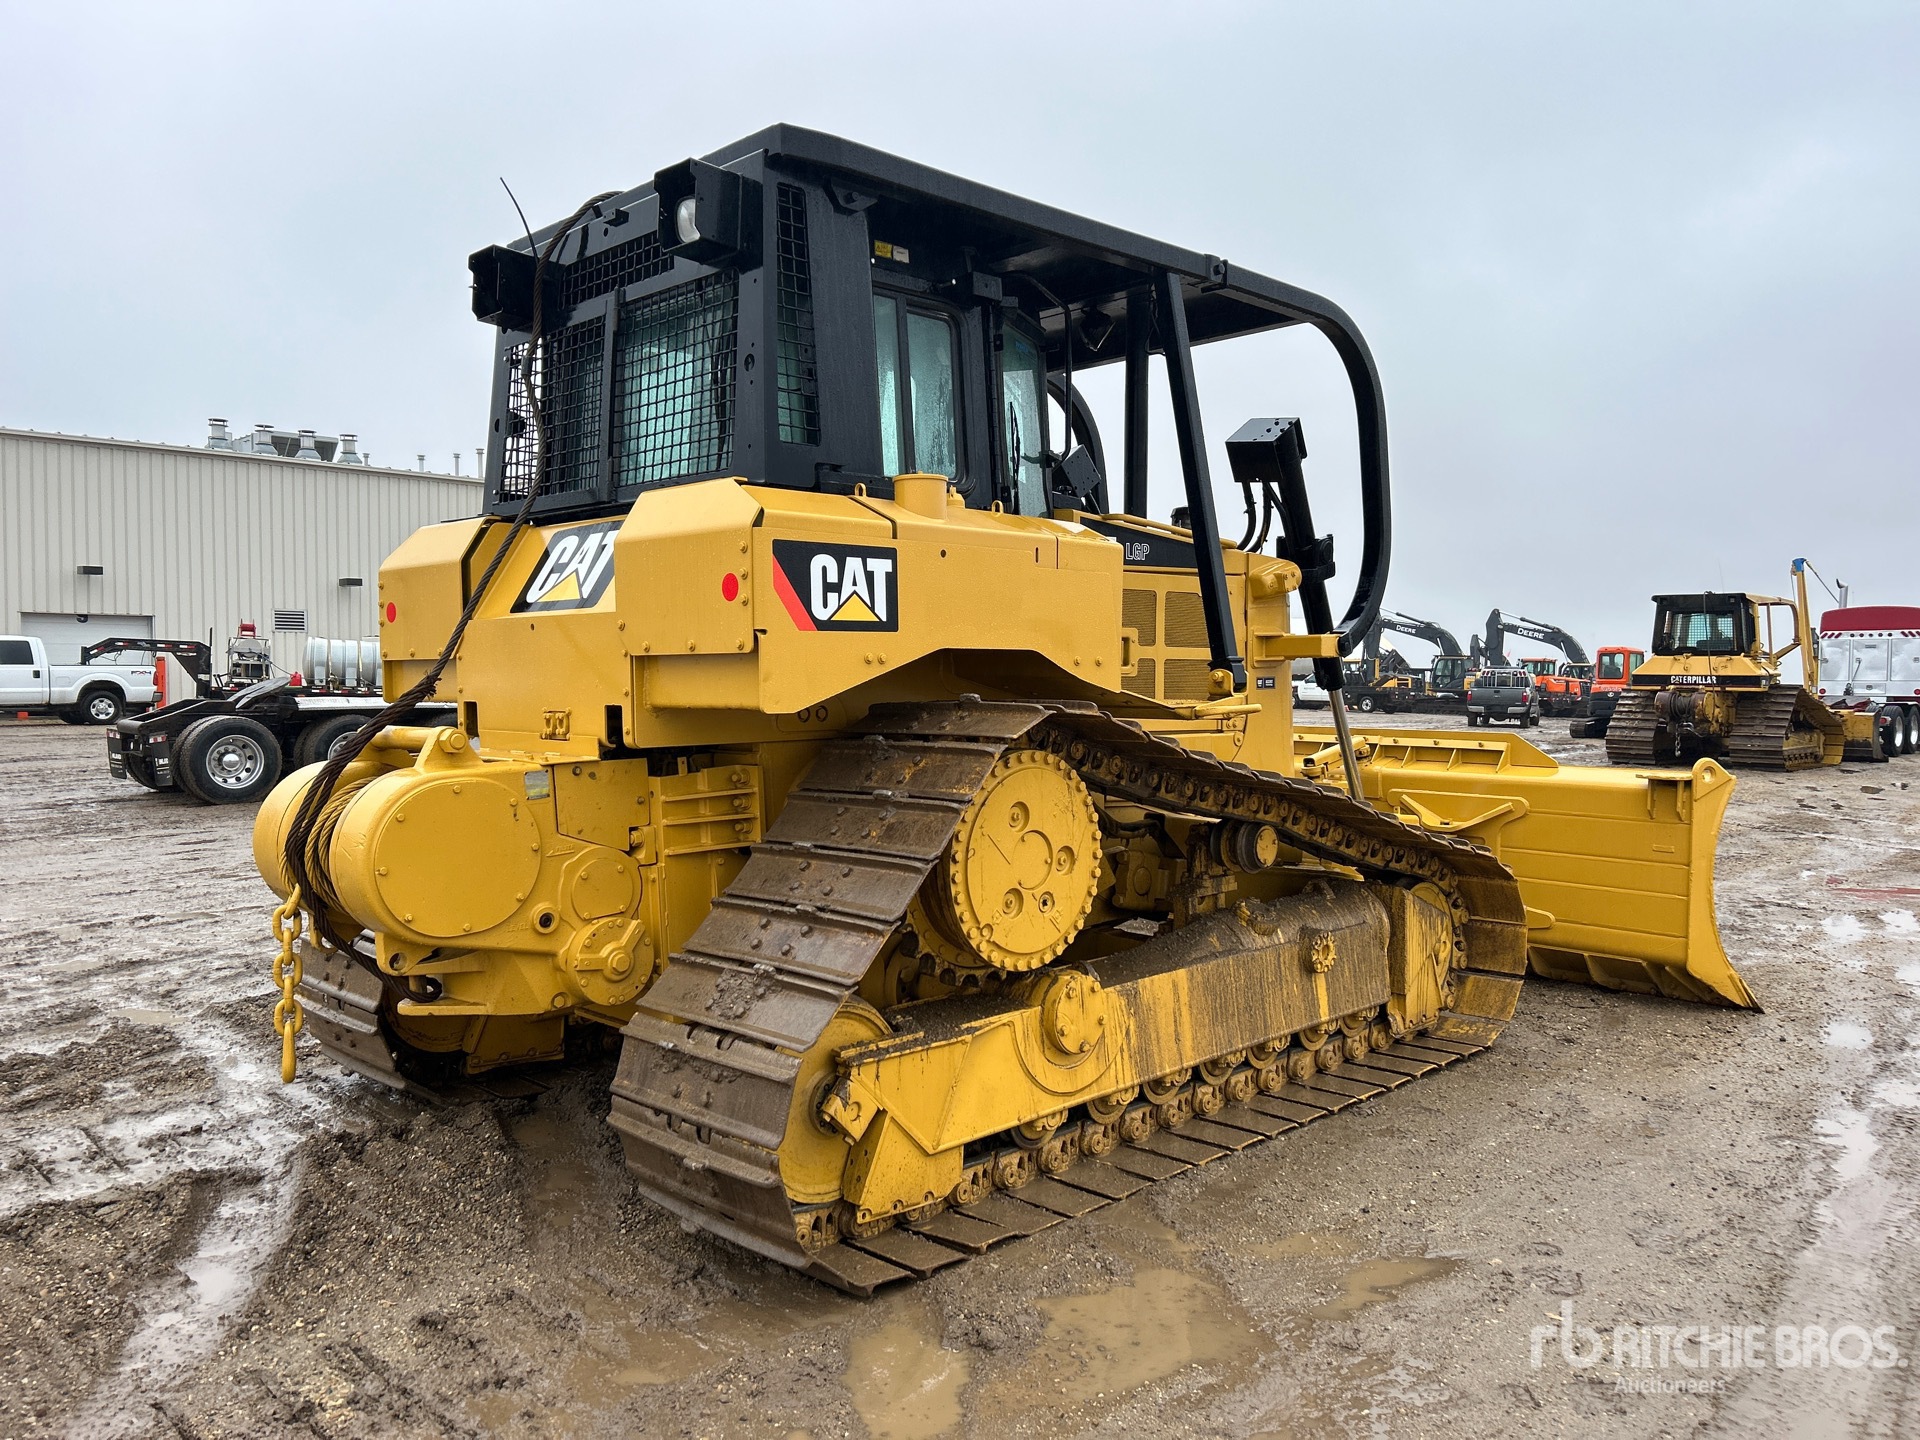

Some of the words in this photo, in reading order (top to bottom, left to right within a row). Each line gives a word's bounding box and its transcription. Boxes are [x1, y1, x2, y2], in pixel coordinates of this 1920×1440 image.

[1125, 542, 1150, 560] LGP
[526, 529, 620, 604] CAT
[810, 553, 893, 622] CAT
[1395, 624, 1417, 634] DEERE
[1517, 627, 1545, 640] DEERE
[1670, 675, 1717, 684] CATERPILLAR
